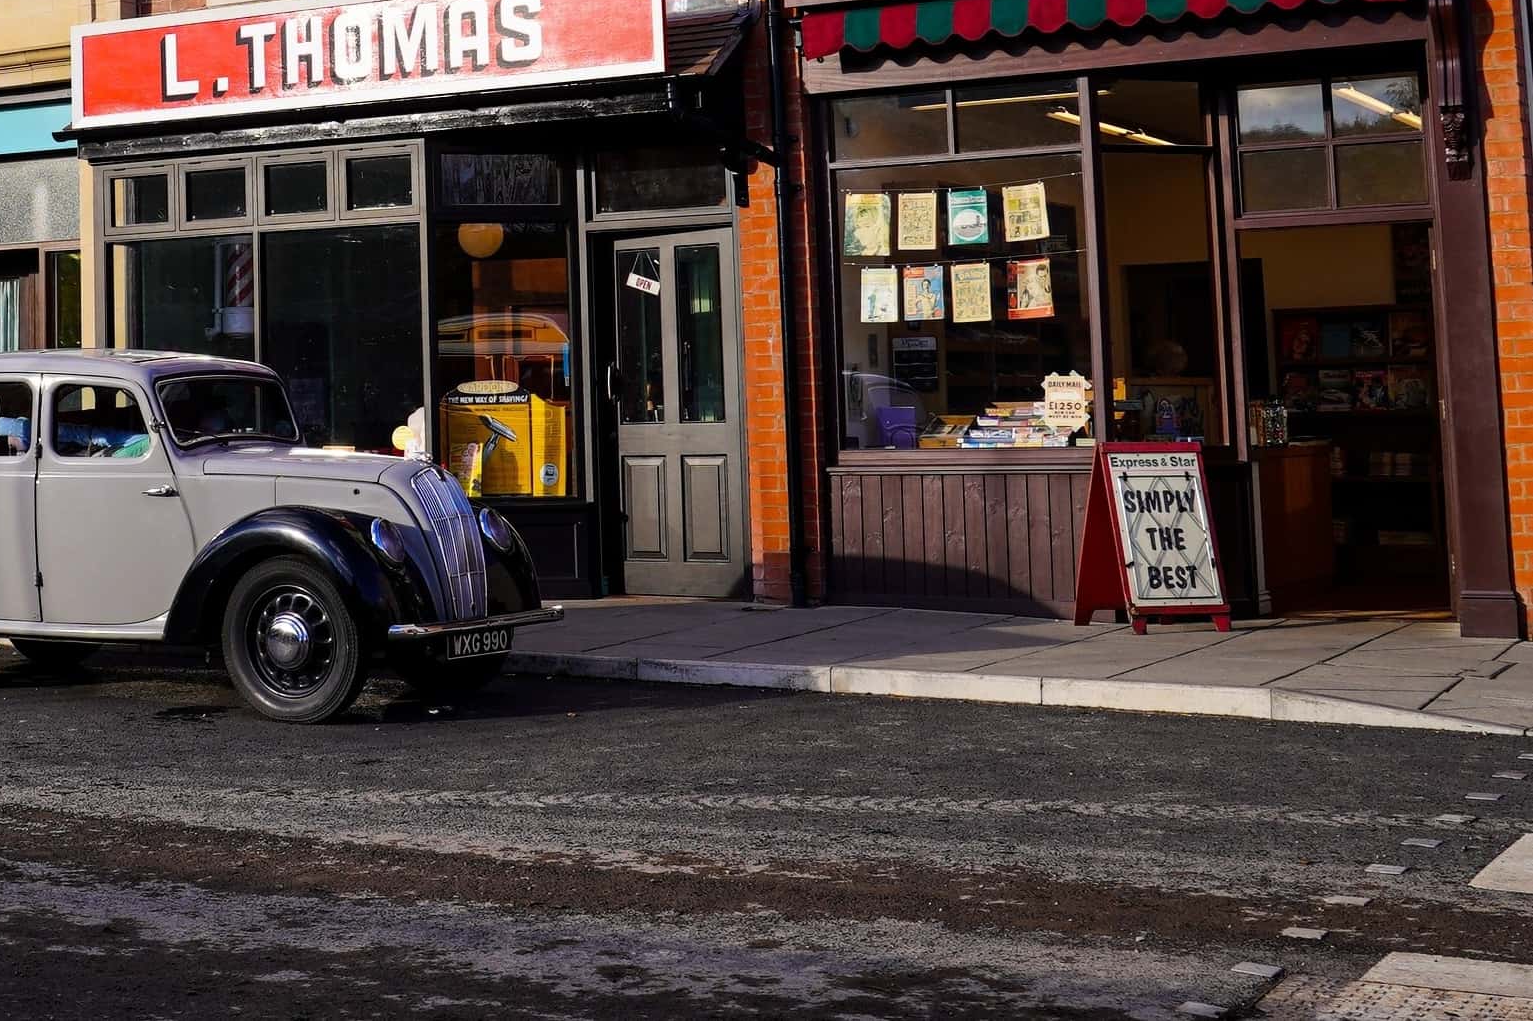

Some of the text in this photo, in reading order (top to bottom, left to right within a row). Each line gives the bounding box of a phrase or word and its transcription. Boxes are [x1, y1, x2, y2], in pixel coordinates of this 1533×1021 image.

[635, 278, 653, 290] OPEN
[488, 395, 498, 403] OF
[1110, 456, 1196, 469] Express & Star
[1124, 489, 1196, 513] SIMPLY
[1146, 527, 1186, 551] THE
[1147, 565, 1198, 590] BEST
[453, 630, 508, 655] WXG 990
